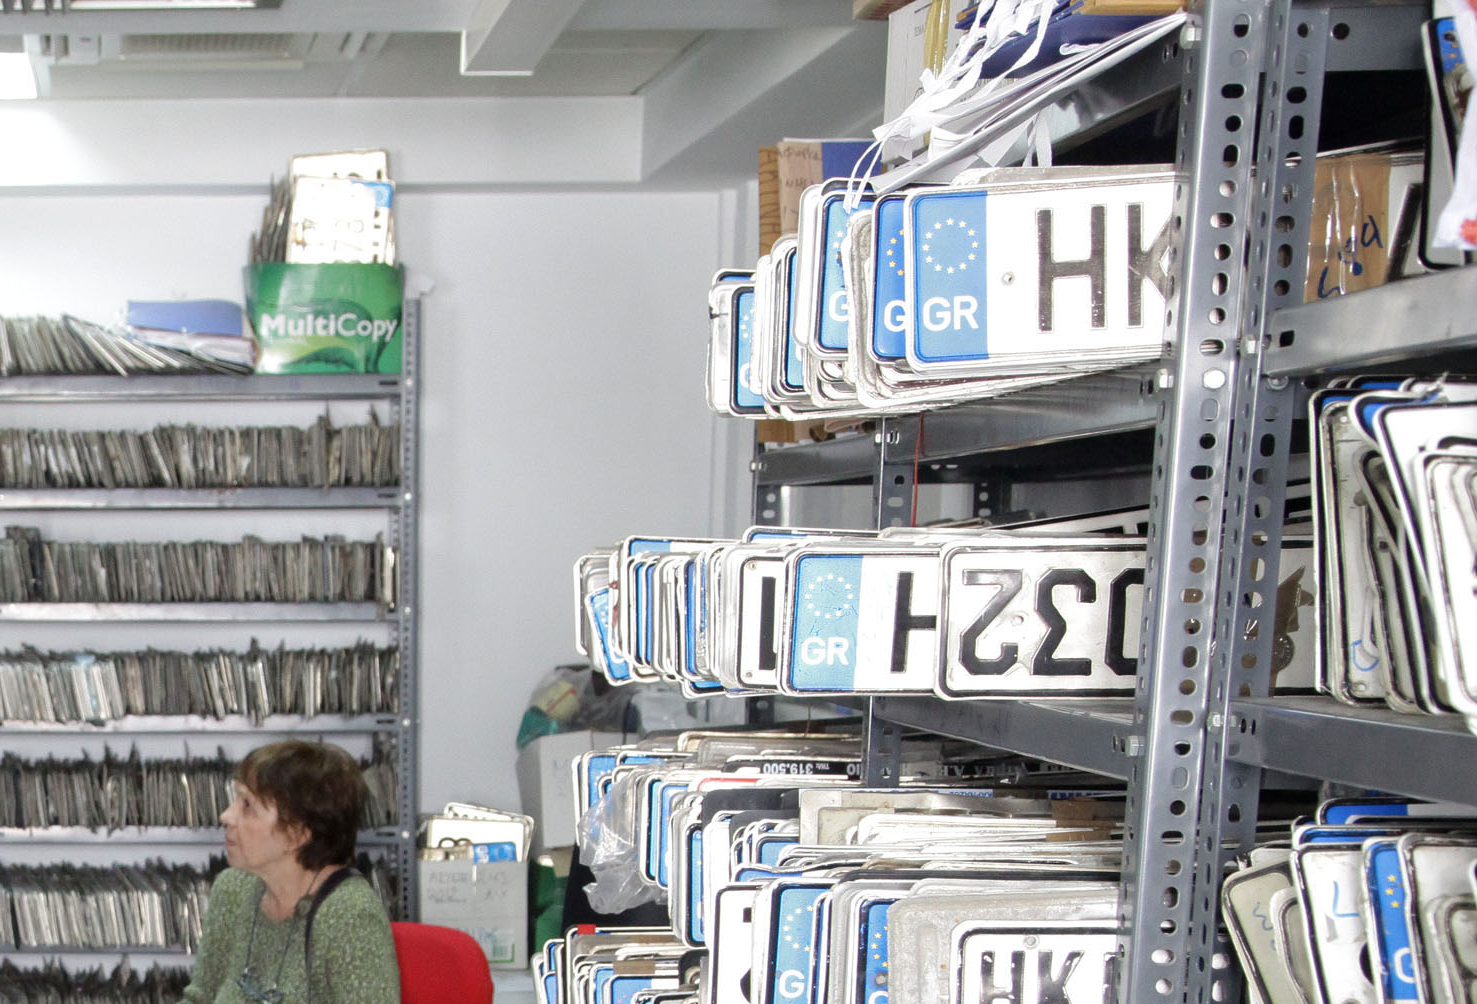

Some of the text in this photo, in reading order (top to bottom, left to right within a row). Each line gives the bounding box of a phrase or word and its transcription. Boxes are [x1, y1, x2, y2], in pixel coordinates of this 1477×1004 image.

[923, 202, 1174, 333] GR HK
[829, 290, 850, 321] G
[884, 300, 906, 332] G
[259, 313, 398, 341] MultiCopy
[800, 637, 850, 666] GR
[763, 763, 814, 775] 319.500
[778, 969, 805, 999] G
